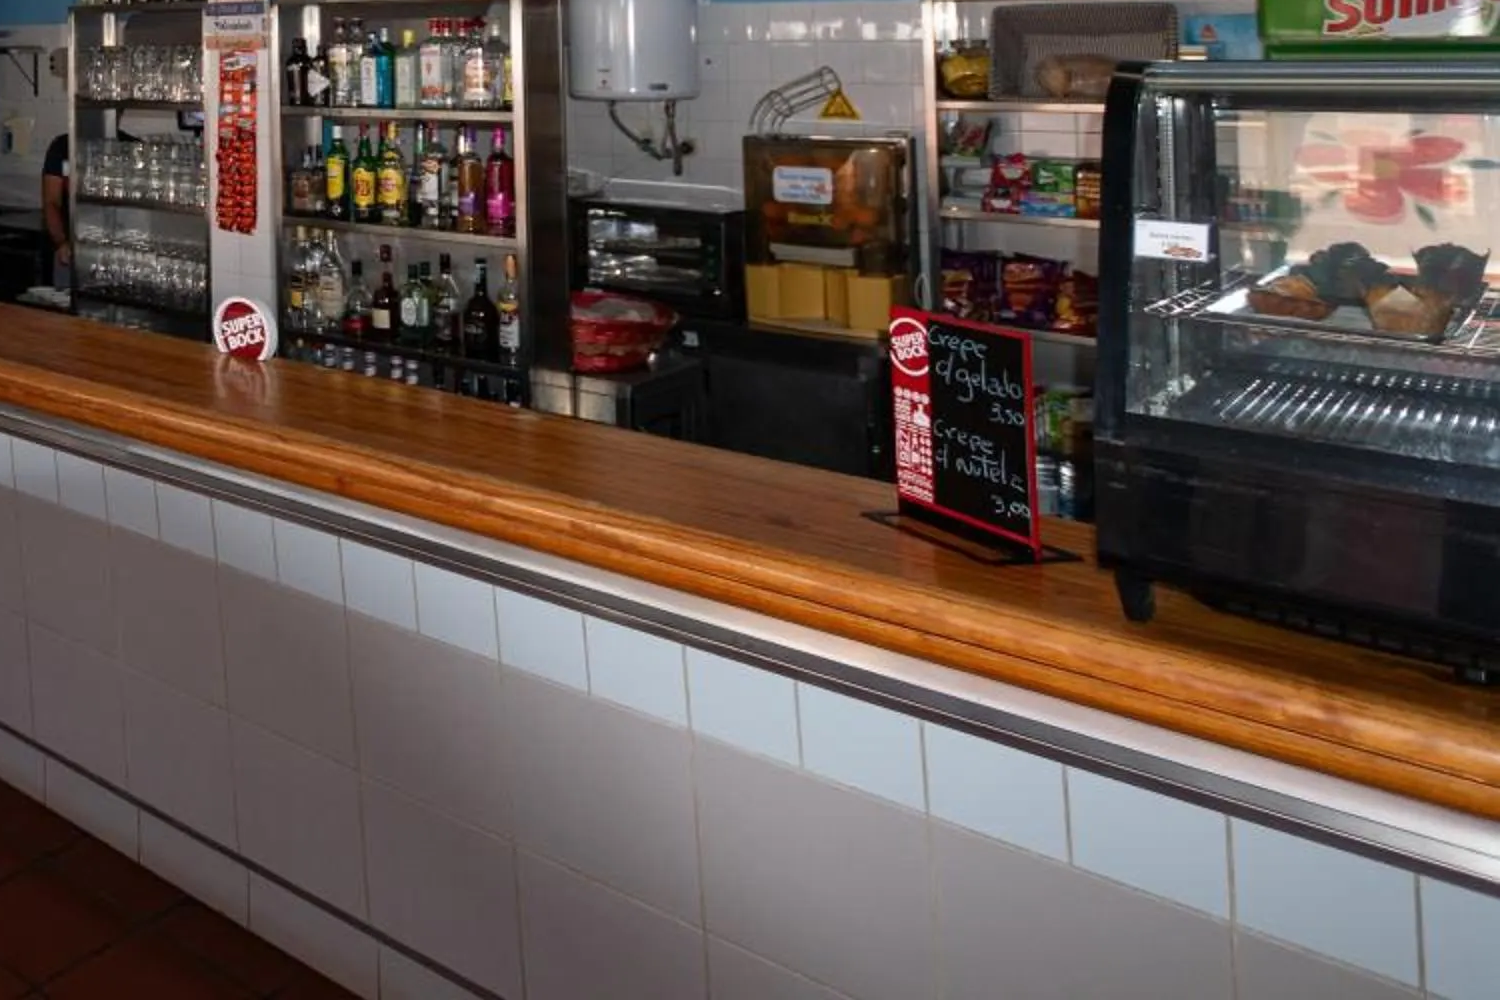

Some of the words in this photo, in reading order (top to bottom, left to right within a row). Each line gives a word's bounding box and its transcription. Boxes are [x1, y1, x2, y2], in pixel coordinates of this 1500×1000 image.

[222, 313, 262, 336] SUPER
[228, 328, 264, 349] BOCK
[891, 331, 924, 349] SUPER
[928, 325, 987, 360] Crepe
[898, 344, 929, 361] BOCK
[933, 418, 994, 455] Crepe
